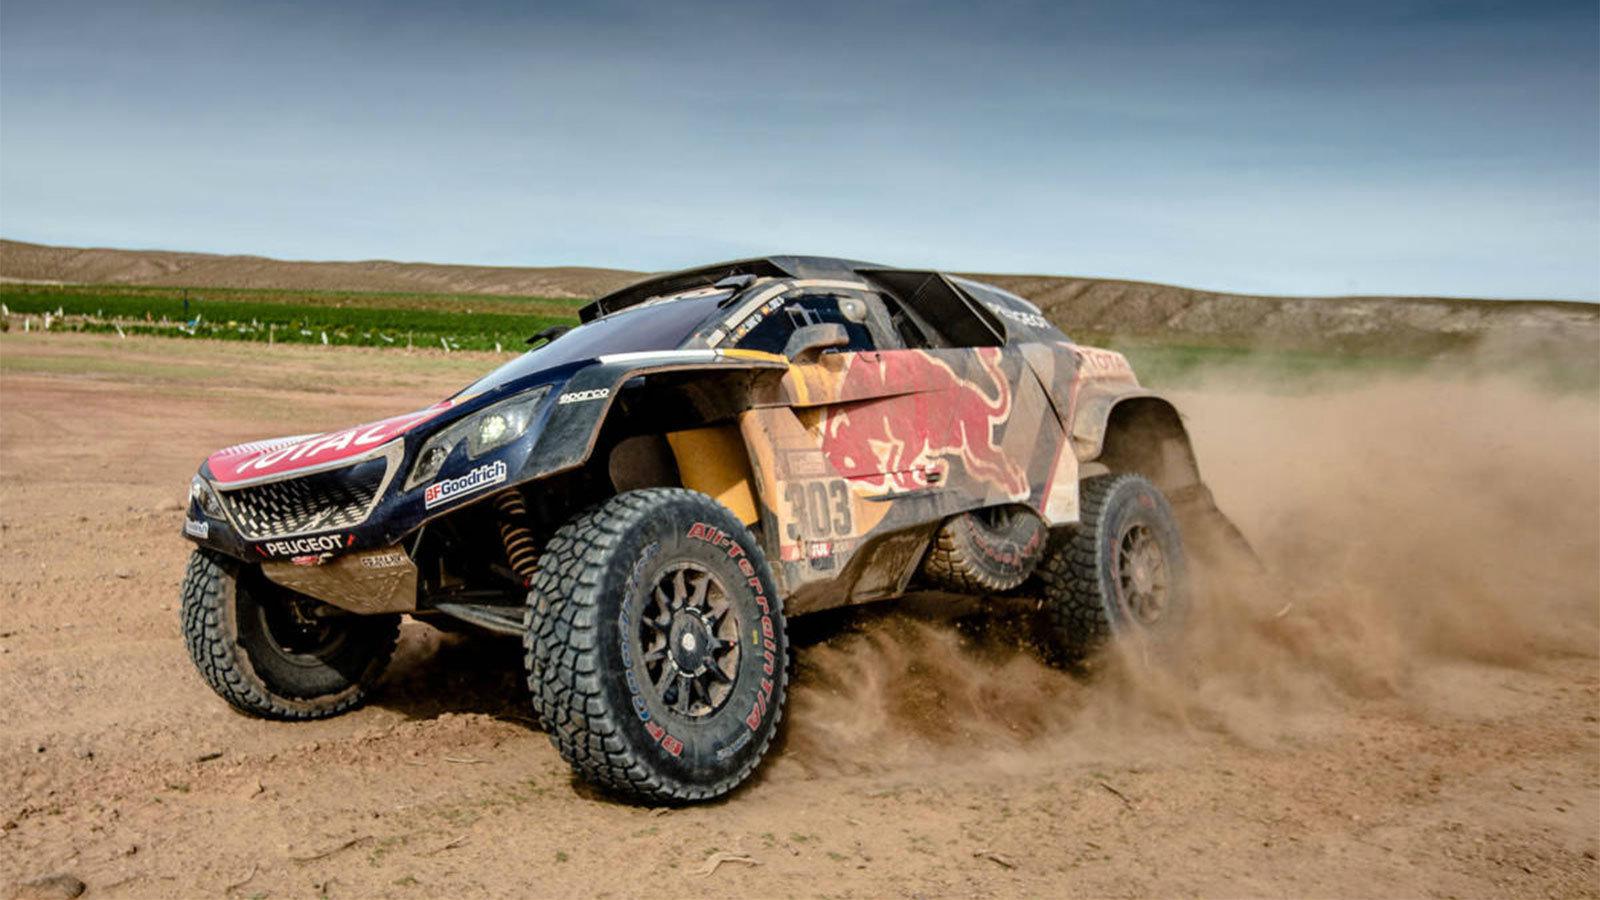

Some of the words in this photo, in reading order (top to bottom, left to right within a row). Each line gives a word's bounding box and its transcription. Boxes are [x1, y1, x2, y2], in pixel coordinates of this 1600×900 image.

[558, 388, 609, 404] sparco
[236, 424, 387, 474] TOTAL
[426, 461, 506, 503] BFGoodrich
[784, 479, 853, 540] 303
[265, 534, 344, 557] PEUGEOT
[687, 521, 776, 676] All-Terrain
